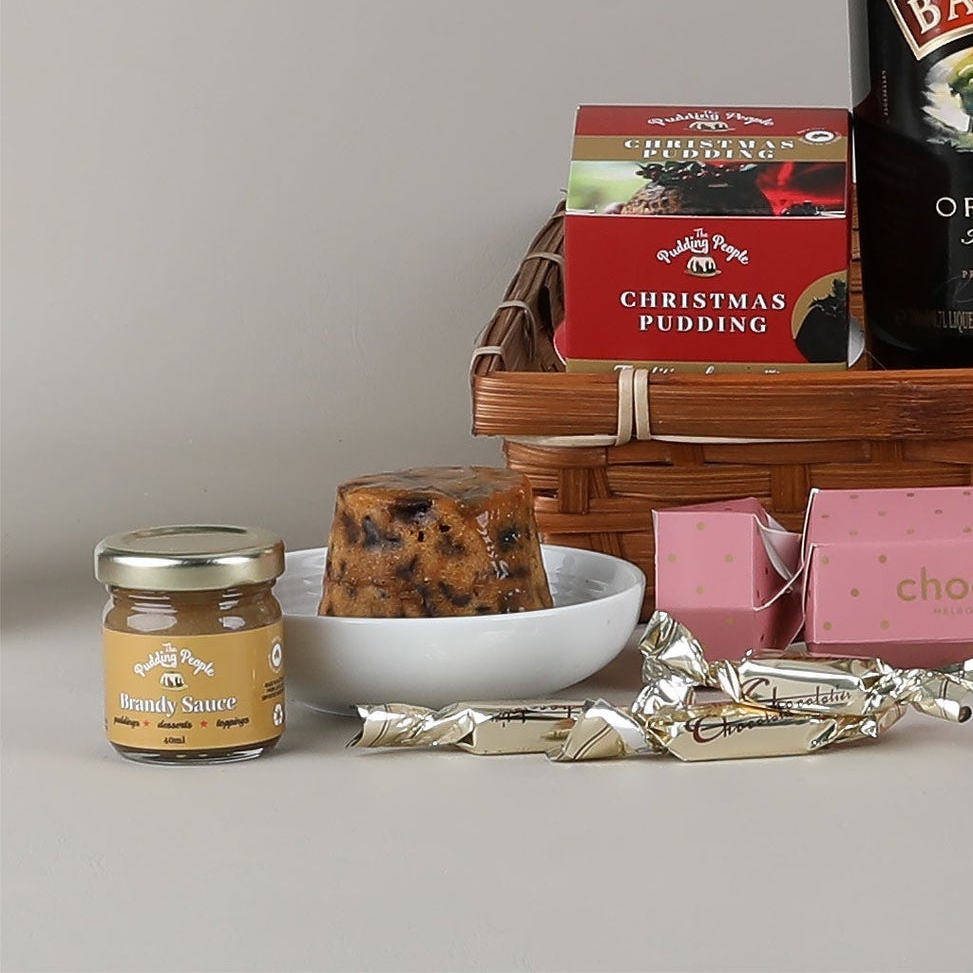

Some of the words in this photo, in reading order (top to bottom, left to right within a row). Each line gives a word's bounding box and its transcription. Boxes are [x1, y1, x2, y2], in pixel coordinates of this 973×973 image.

[623, 139, 796, 149] CHRISTMAS
[642, 149, 775, 159] PUDDING
[693, 227, 708, 238] The
[656, 235, 709, 264] Pudding
[712, 234, 750, 265] People
[620, 290, 786, 311] CHRISTMAS
[639, 315, 768, 333] PUDDING
[162, 642, 177, 653] The
[134, 650, 178, 677] Pudding
[180, 648, 215, 677] People
[120, 692, 176, 717] Brandy
[182, 696, 237, 713] Sauce
